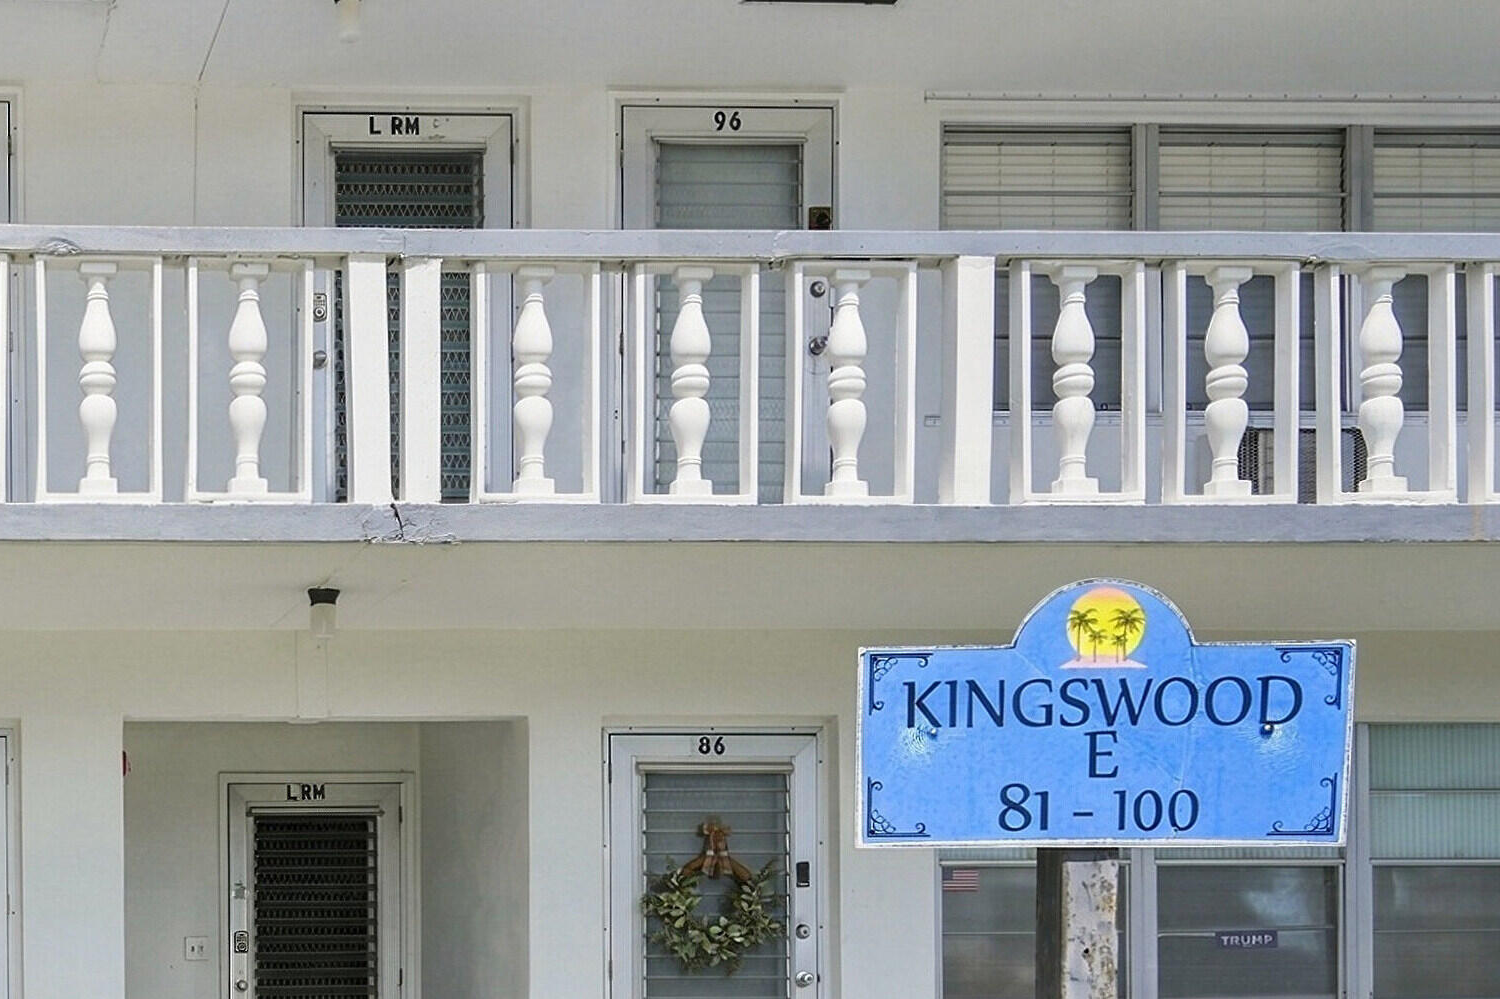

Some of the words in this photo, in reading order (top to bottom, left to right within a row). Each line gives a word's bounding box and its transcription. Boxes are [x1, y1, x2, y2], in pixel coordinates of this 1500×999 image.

[391, 116, 420, 135] RM
[714, 111, 742, 131] 96
[902, 675, 1304, 728] KINGSWOOD
[698, 736, 726, 755] 86
[1085, 730, 1119, 779] E
[999, 783, 1049, 832] 81
[1113, 788, 1200, 832] 100
[1220, 934, 1273, 946] TRUMP
